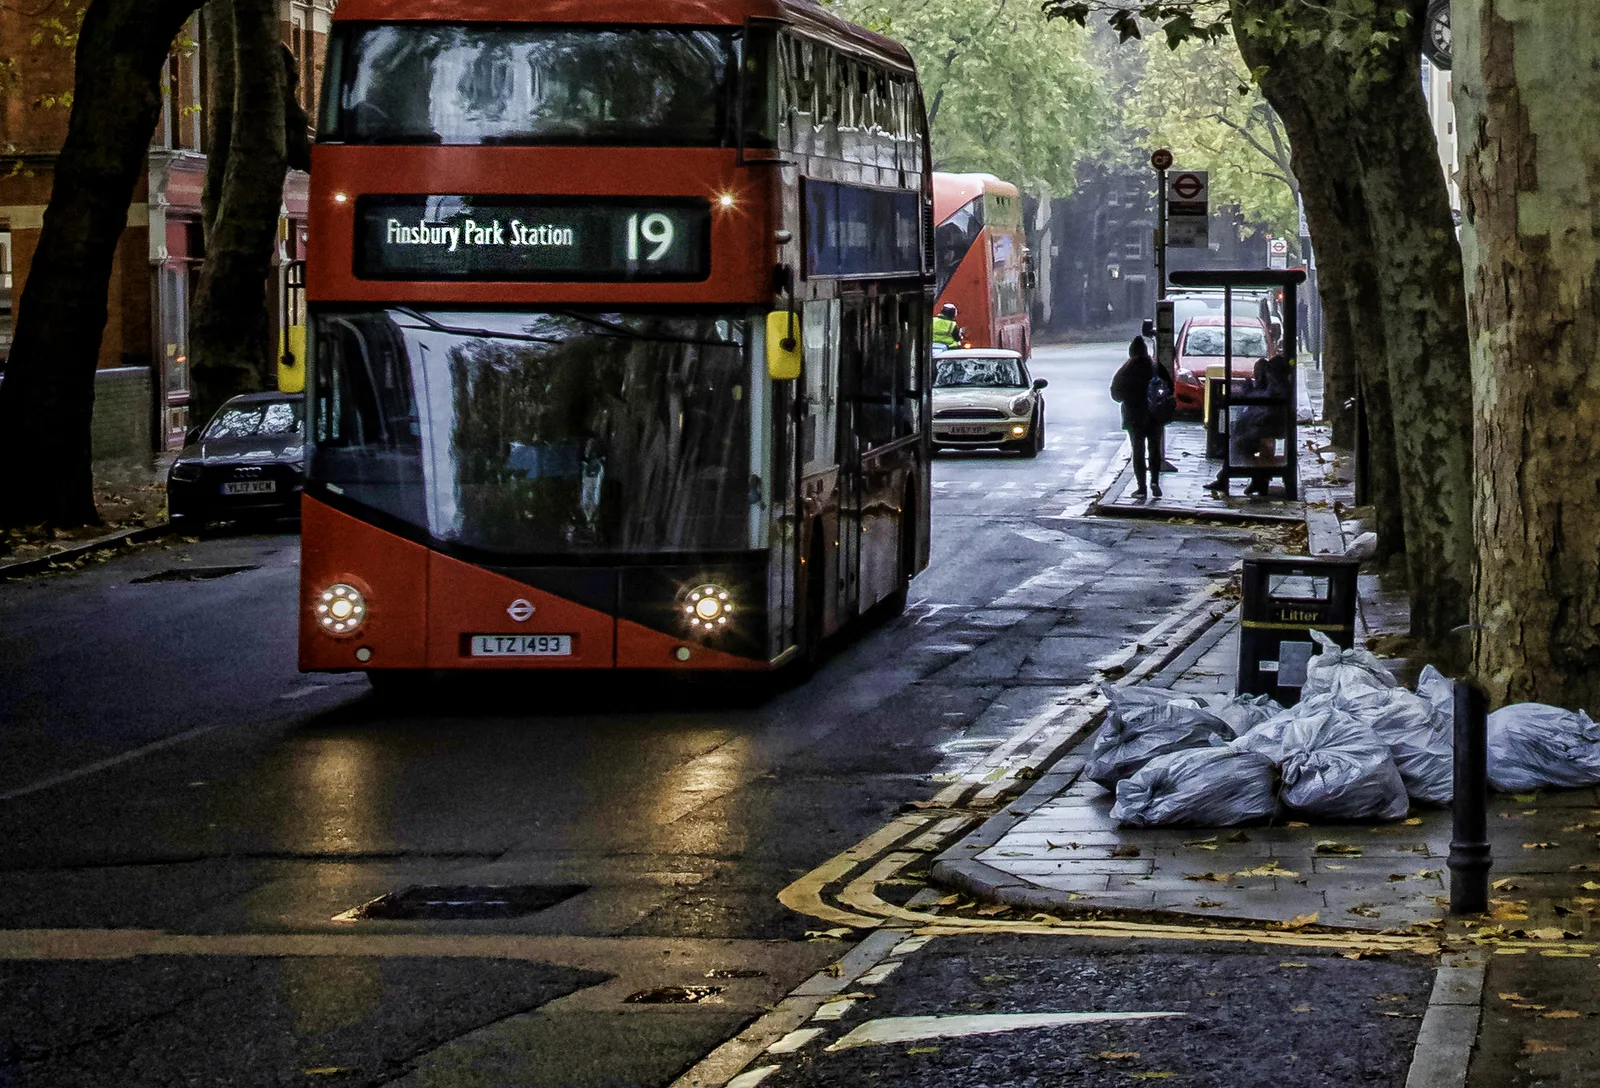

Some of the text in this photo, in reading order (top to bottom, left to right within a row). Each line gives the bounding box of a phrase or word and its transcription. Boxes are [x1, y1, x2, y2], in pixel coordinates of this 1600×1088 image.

[387, 218, 574, 251] Finsbury Park Station
[627, 213, 675, 261] 19
[1281, 608, 1319, 622] Litter
